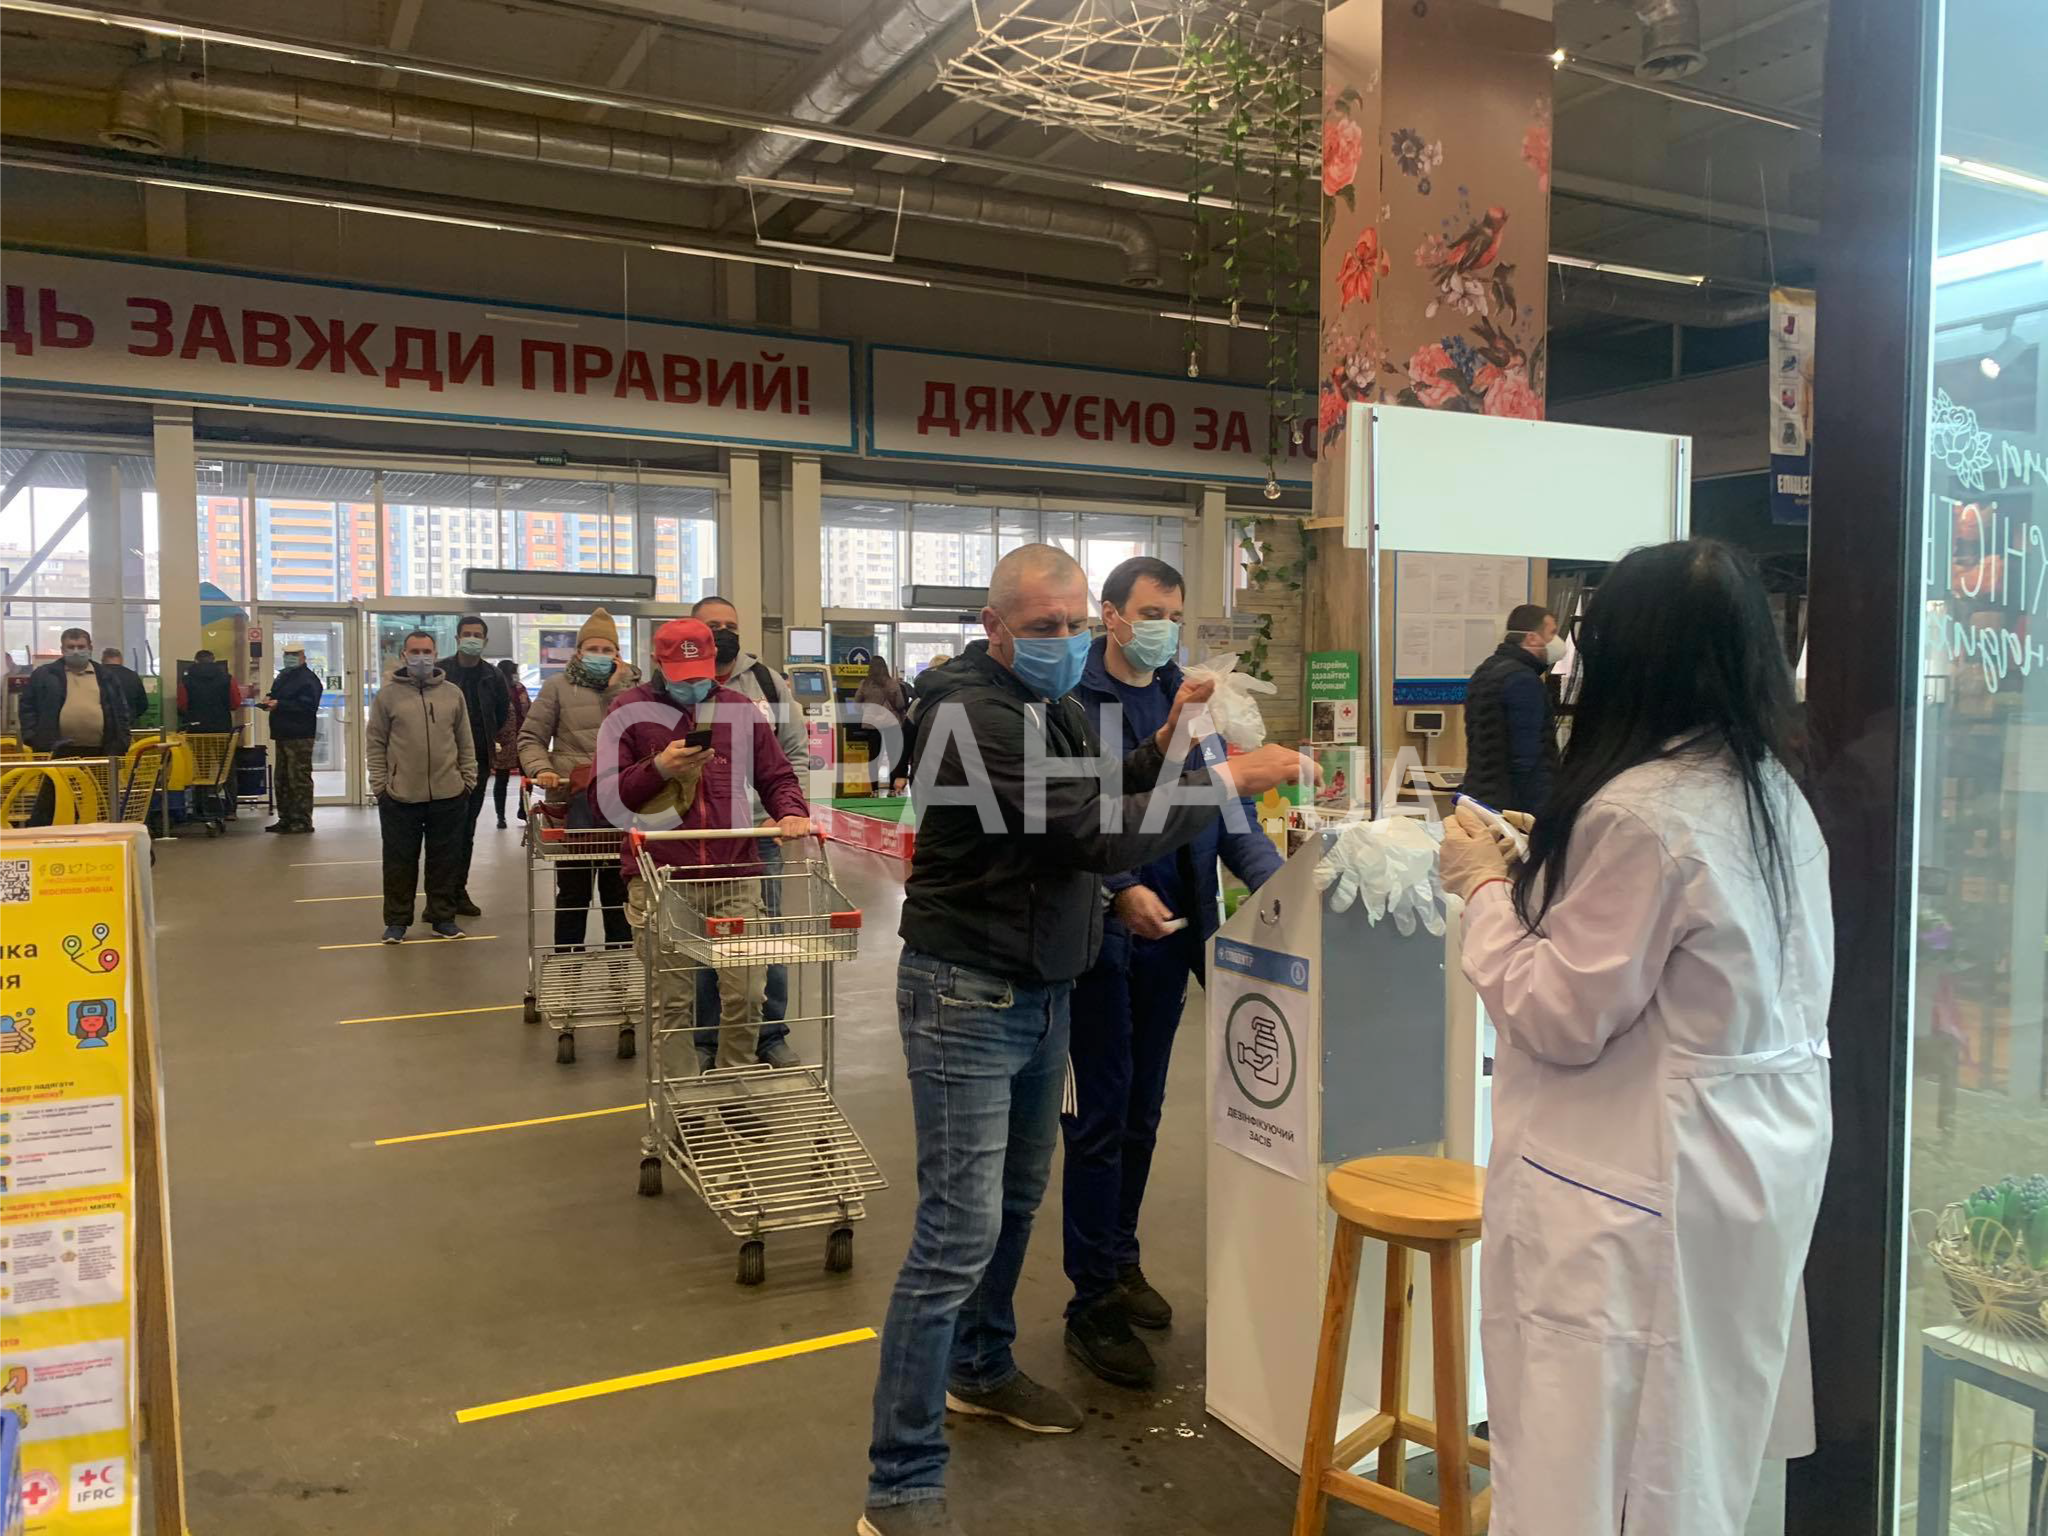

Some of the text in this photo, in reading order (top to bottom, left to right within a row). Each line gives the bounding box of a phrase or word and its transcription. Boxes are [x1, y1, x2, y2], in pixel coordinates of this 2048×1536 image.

[126, 296, 497, 393] ЗАВЖДИ
[520, 338, 812, 416] ПРАВИЙ!
[917, 381, 1177, 447] ДЯКУЄМО
[1193, 407, 1253, 454] ЗА
[0, 943, 38, 960] ка
[1227, 1106, 1295, 1143] ДЕЗІНФІКУЮЧИЙ
[1249, 1130, 1273, 1148] ЗАСІБ
[78, 1487, 116, 1503] IFRC
